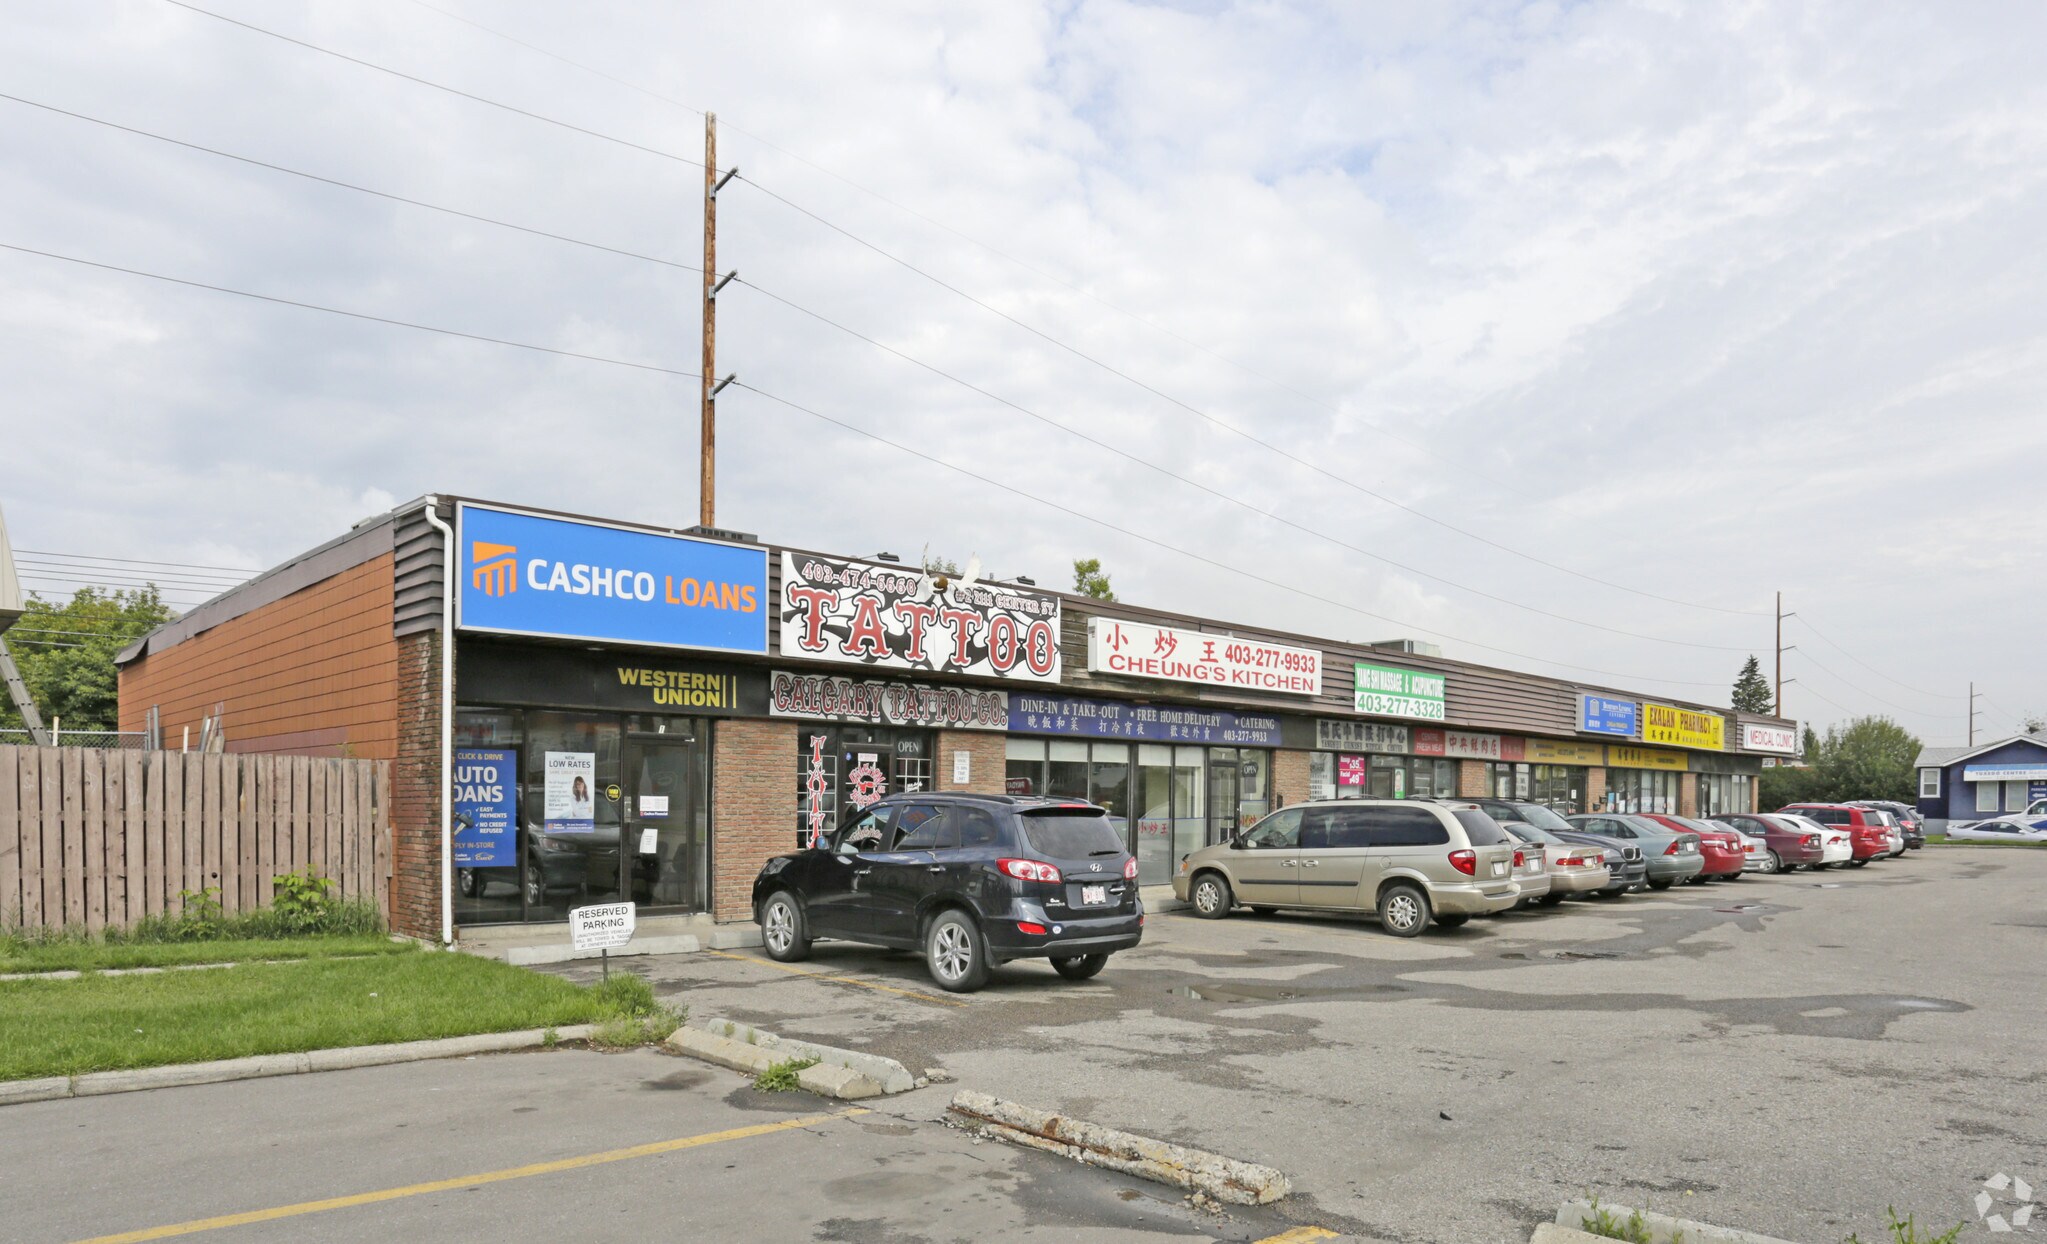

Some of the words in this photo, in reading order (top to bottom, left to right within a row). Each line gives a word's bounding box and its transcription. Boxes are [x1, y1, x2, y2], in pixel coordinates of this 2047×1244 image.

[527, 558, 655, 602] CASHCO
[665, 575, 757, 613] LOANS
[801, 562, 917, 596] 403-474-6660
[996, 594, 1040, 614] CENTER
[1041, 601, 1057, 617] ST.
[786, 580, 1059, 676] TATTOO
[617, 667, 720, 690] WESTERN
[1108, 654, 1226, 682] CHEUNG'S
[1232, 669, 1314, 692] KITCHEN
[1380, 670, 1403, 693] MASSAGE
[1411, 675, 1444, 698] ACUPUNCTURE
[653, 688, 720, 707] UNION
[774, 674, 884, 718] CALGARY
[888, 685, 973, 723] TATTOO
[976, 692, 1008, 726] CO.
[1357, 694, 1443, 719] 403-277-3328
[1020, 699, 1058, 715] DINE-IN
[1062, 705, 1070, 715] &
[1137, 709, 1157, 722] FREE
[1160, 711, 1183, 724] HOME
[1184, 713, 1221, 727] DELIVERY
[1240, 717, 1275, 730] CATERING
[1649, 707, 1675, 729] EXALAN
[1680, 712, 1711, 734] PHARMACY
[897, 741, 919, 753] OPEN
[1223, 730, 1267, 742] 403-277-9933
[1751, 729, 1775, 746] MEDICAL
[1776, 732, 1793, 748] CLINIC
[458, 752, 476, 760] CLICK
[484, 753, 504, 761] DRIVE
[548, 760, 566, 768] LOW
[1243, 765, 1257, 774] OPEN
[454, 785, 504, 802] OANS
[807, 735, 827, 849] TATT
[578, 907, 628, 919] RESERVED
[583, 917, 624, 930] PARKING
